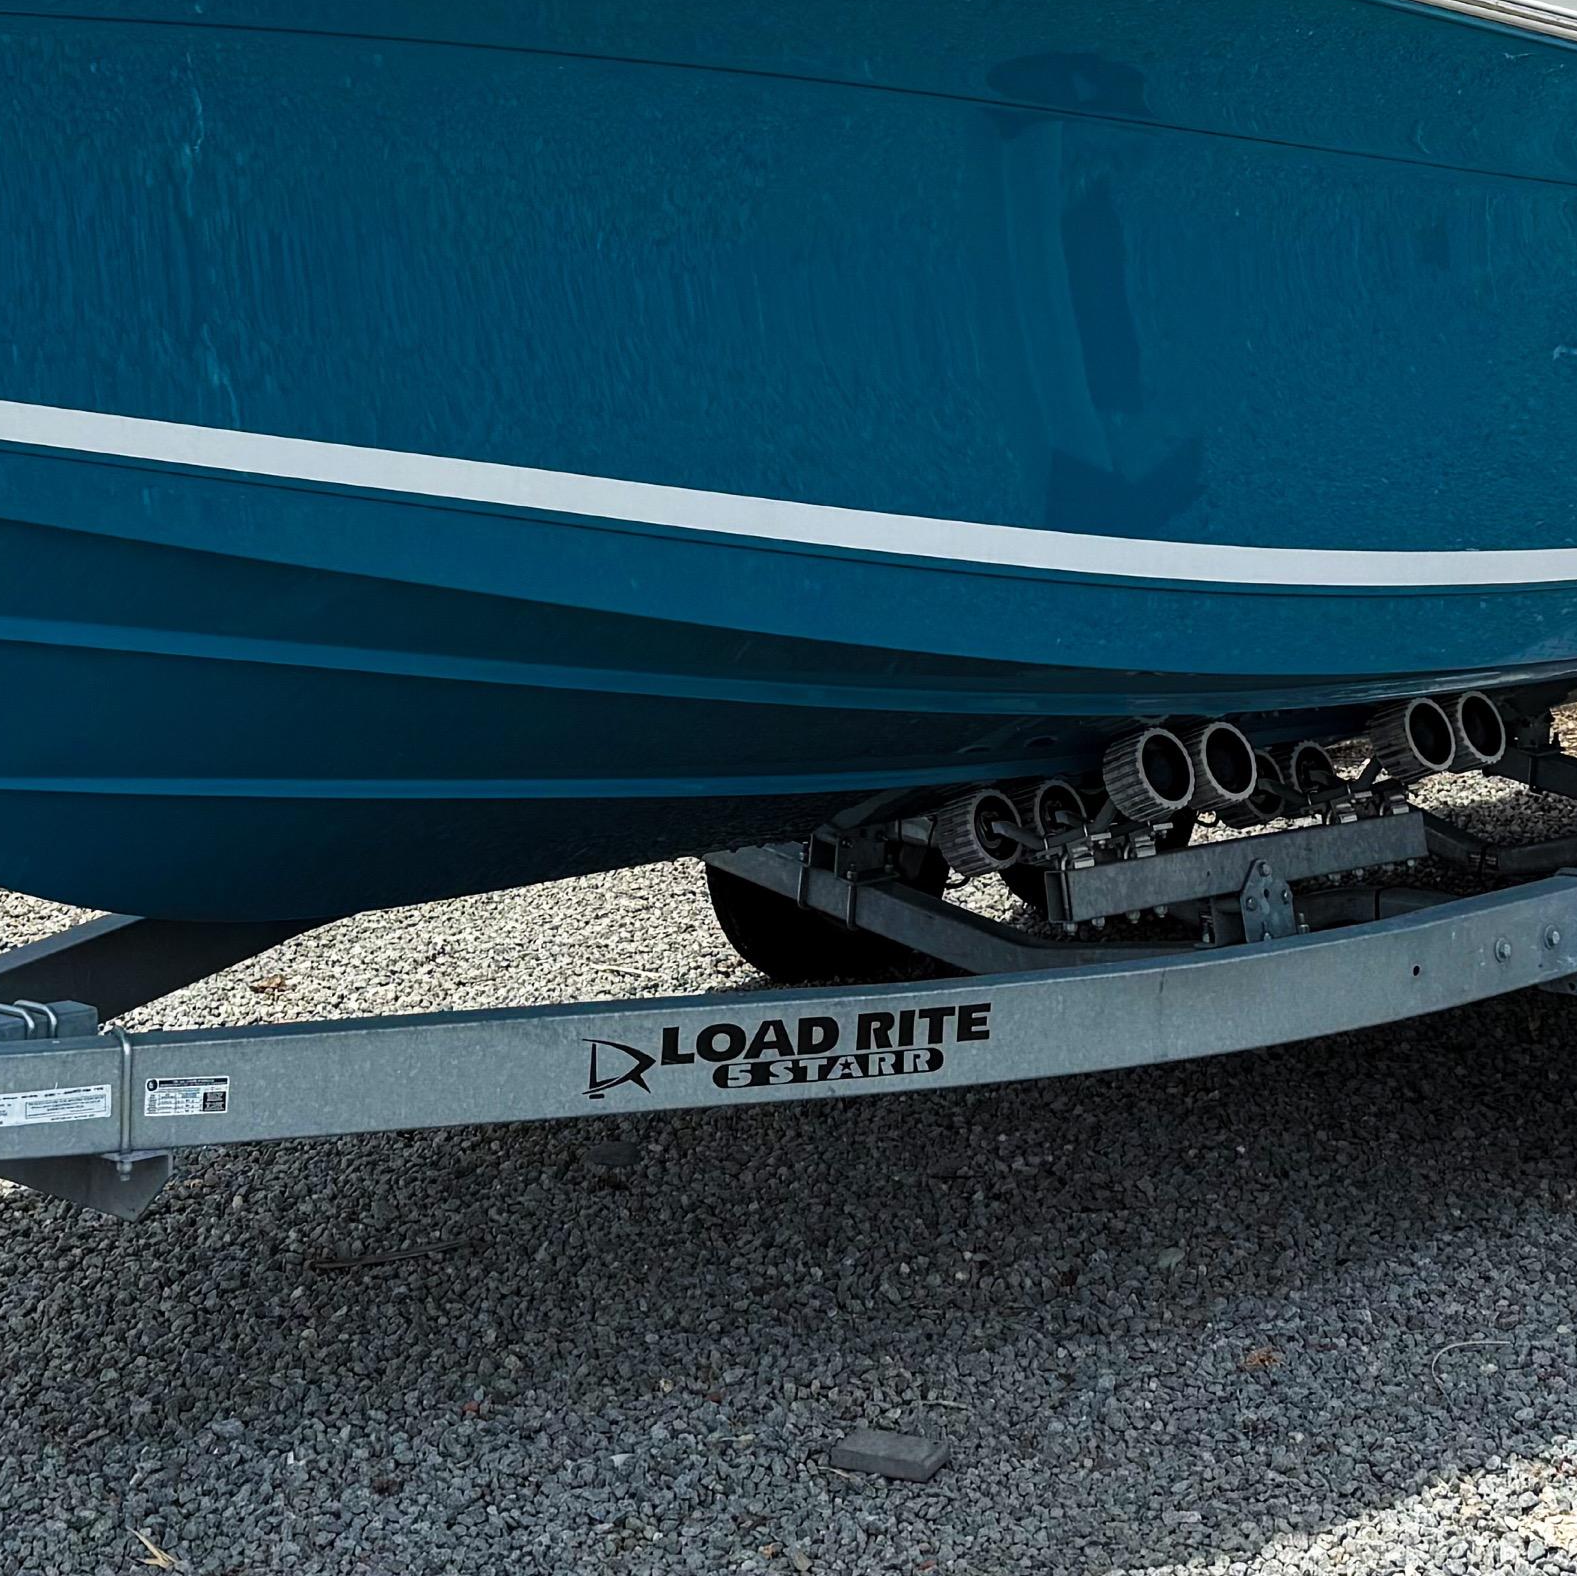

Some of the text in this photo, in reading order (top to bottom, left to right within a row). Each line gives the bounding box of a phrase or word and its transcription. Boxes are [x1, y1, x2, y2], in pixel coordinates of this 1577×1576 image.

[661, 1002, 992, 1066] LOAD RITE
[727, 1049, 931, 1088] 5 STARR
